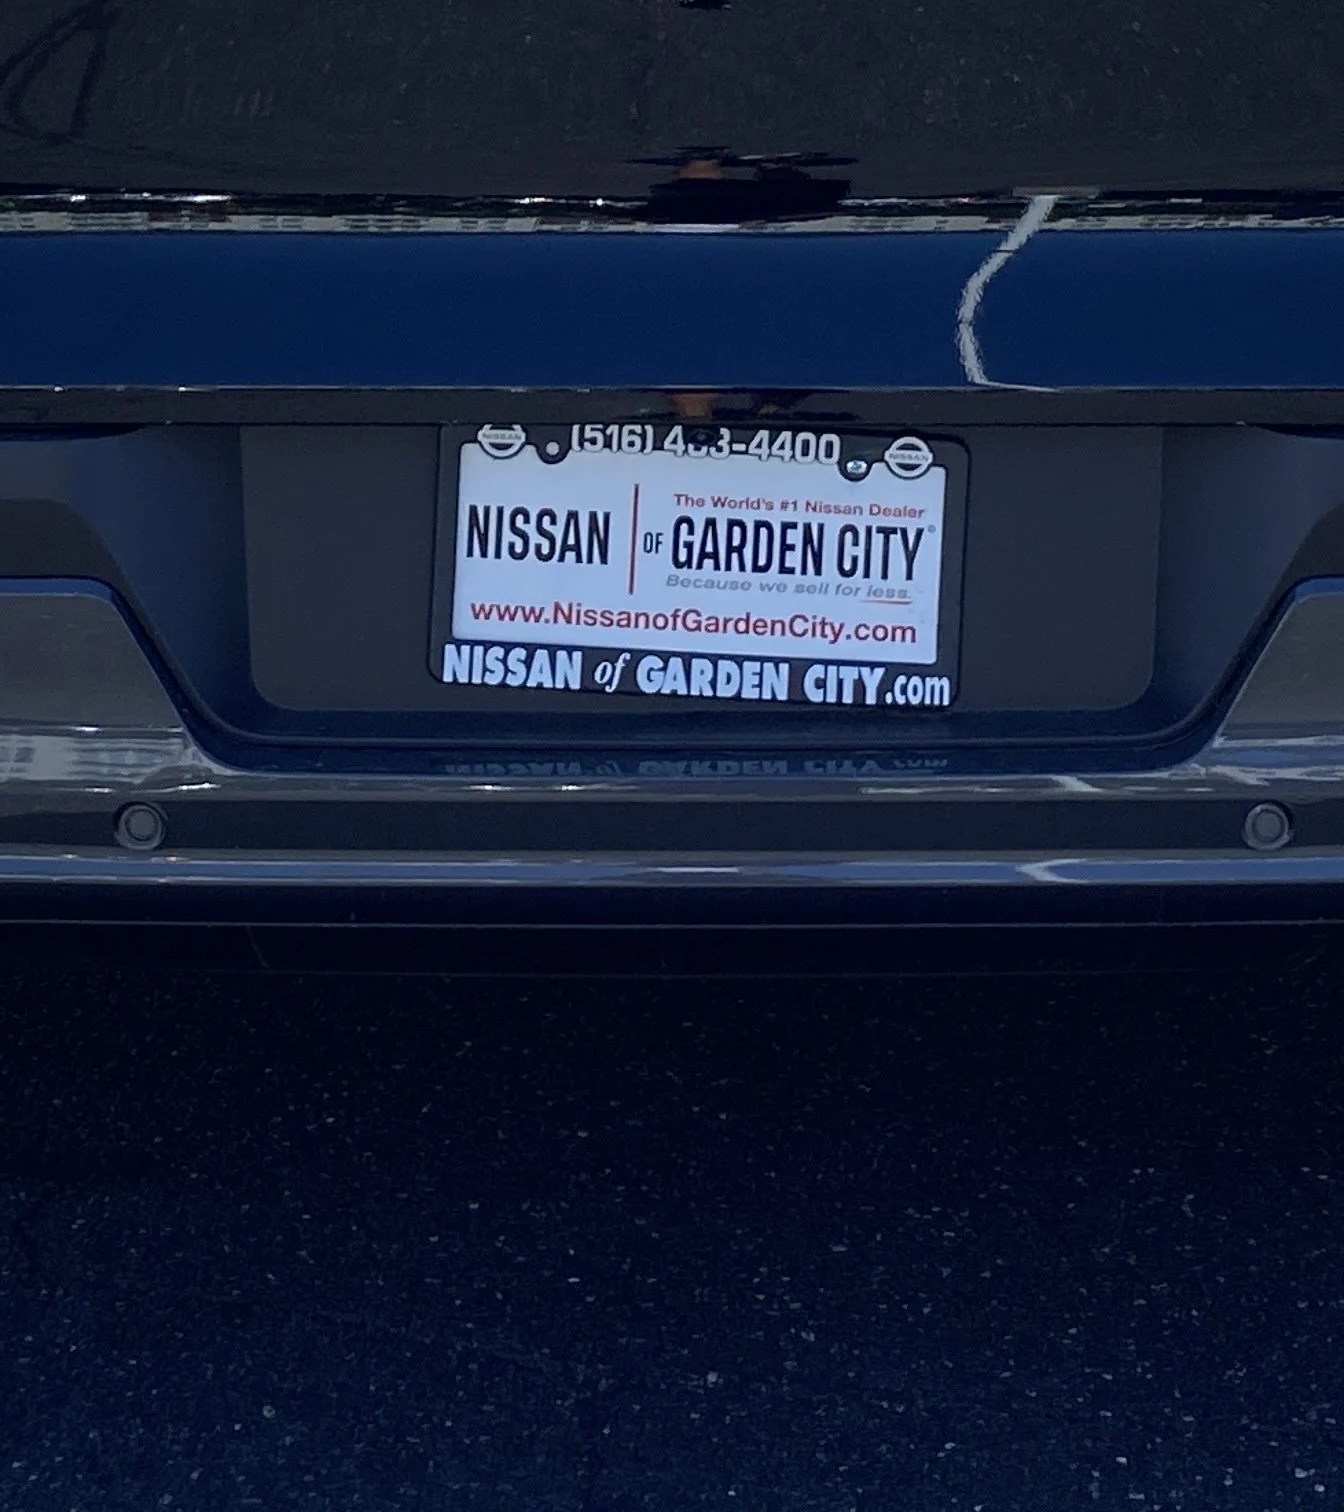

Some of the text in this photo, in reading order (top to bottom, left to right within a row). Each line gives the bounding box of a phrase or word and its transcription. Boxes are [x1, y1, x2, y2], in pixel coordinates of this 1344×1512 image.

[570, 423, 655, 456] (516)
[887, 451, 930, 462] NISSAN
[673, 493, 926, 520] The World's #1 Nissan Dealer
[465, 504, 925, 582] NISSAN OF GARDEN CITY
[665, 573, 913, 601] Because we sell for less.
[470, 600, 917, 645] www.NissanofGardenCity.com
[442, 643, 952, 708] NISSAN of GARDEN CITY.com
